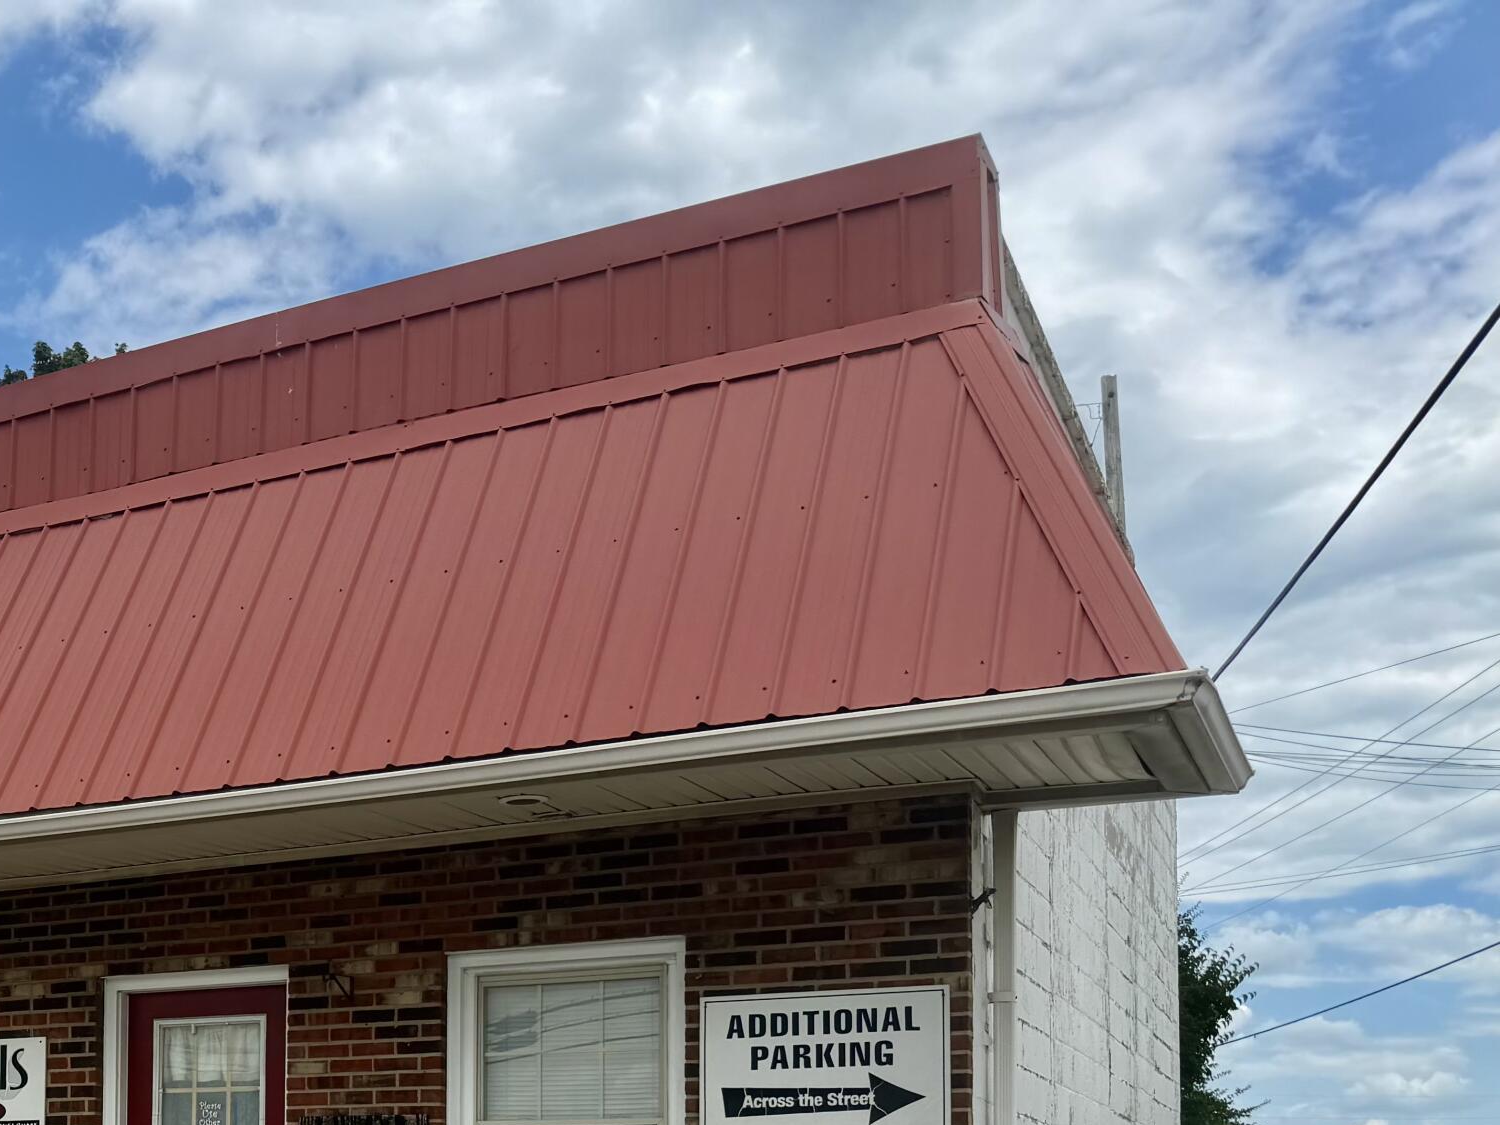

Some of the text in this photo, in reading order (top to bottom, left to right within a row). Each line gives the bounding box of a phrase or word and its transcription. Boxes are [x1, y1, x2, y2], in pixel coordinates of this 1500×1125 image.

[726, 1006, 920, 1039] ADDITIONAL
[750, 1040, 894, 1071] PARKING
[742, 1091, 876, 1108] Across the Street
[202, 1110, 218, 1119] Use
